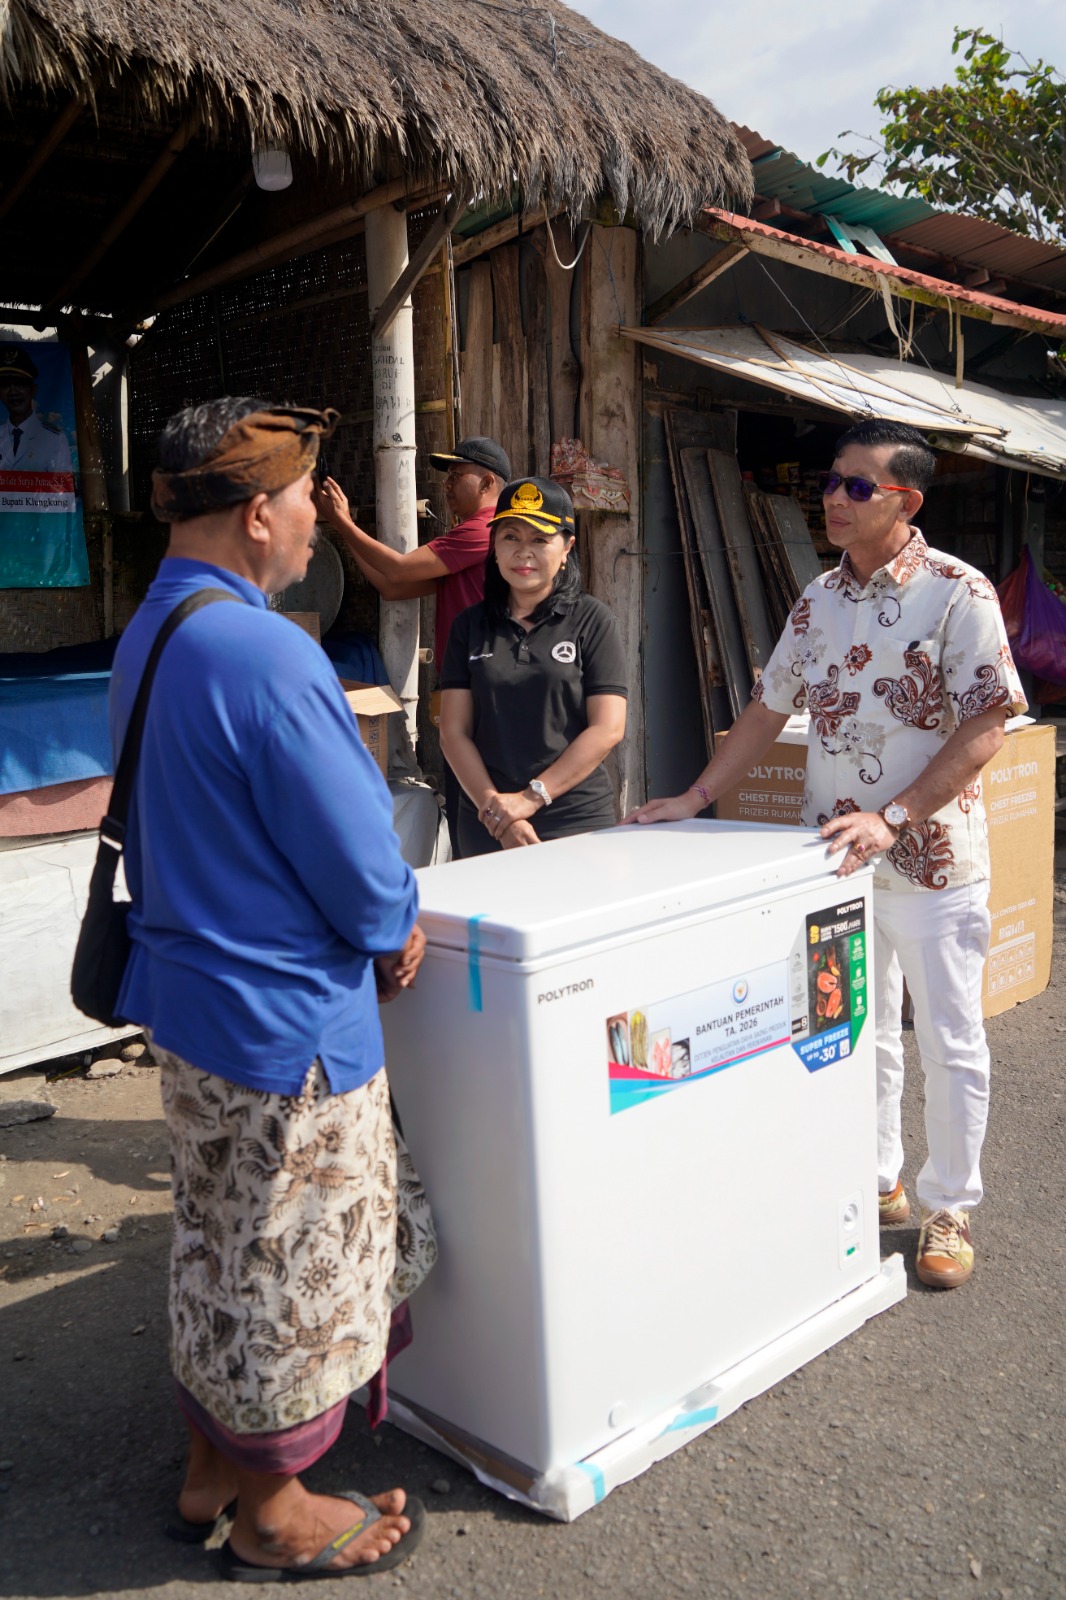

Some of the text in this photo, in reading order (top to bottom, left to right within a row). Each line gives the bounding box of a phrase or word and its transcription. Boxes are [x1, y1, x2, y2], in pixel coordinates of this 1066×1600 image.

[1, 497, 69, 508] Bupati Klungkung
[738, 792, 804, 806] CHEST FREEZ
[990, 790, 1037, 812] CHEST FREEZER
[738, 807, 770, 817] FRIZER
[695, 1013, 734, 1037] BANTUAN
[734, 995, 785, 1021] PEMERINTAH
[724, 1017, 759, 1038] TA. 2026
[800, 1026, 850, 1056] SUPER FREEZE
